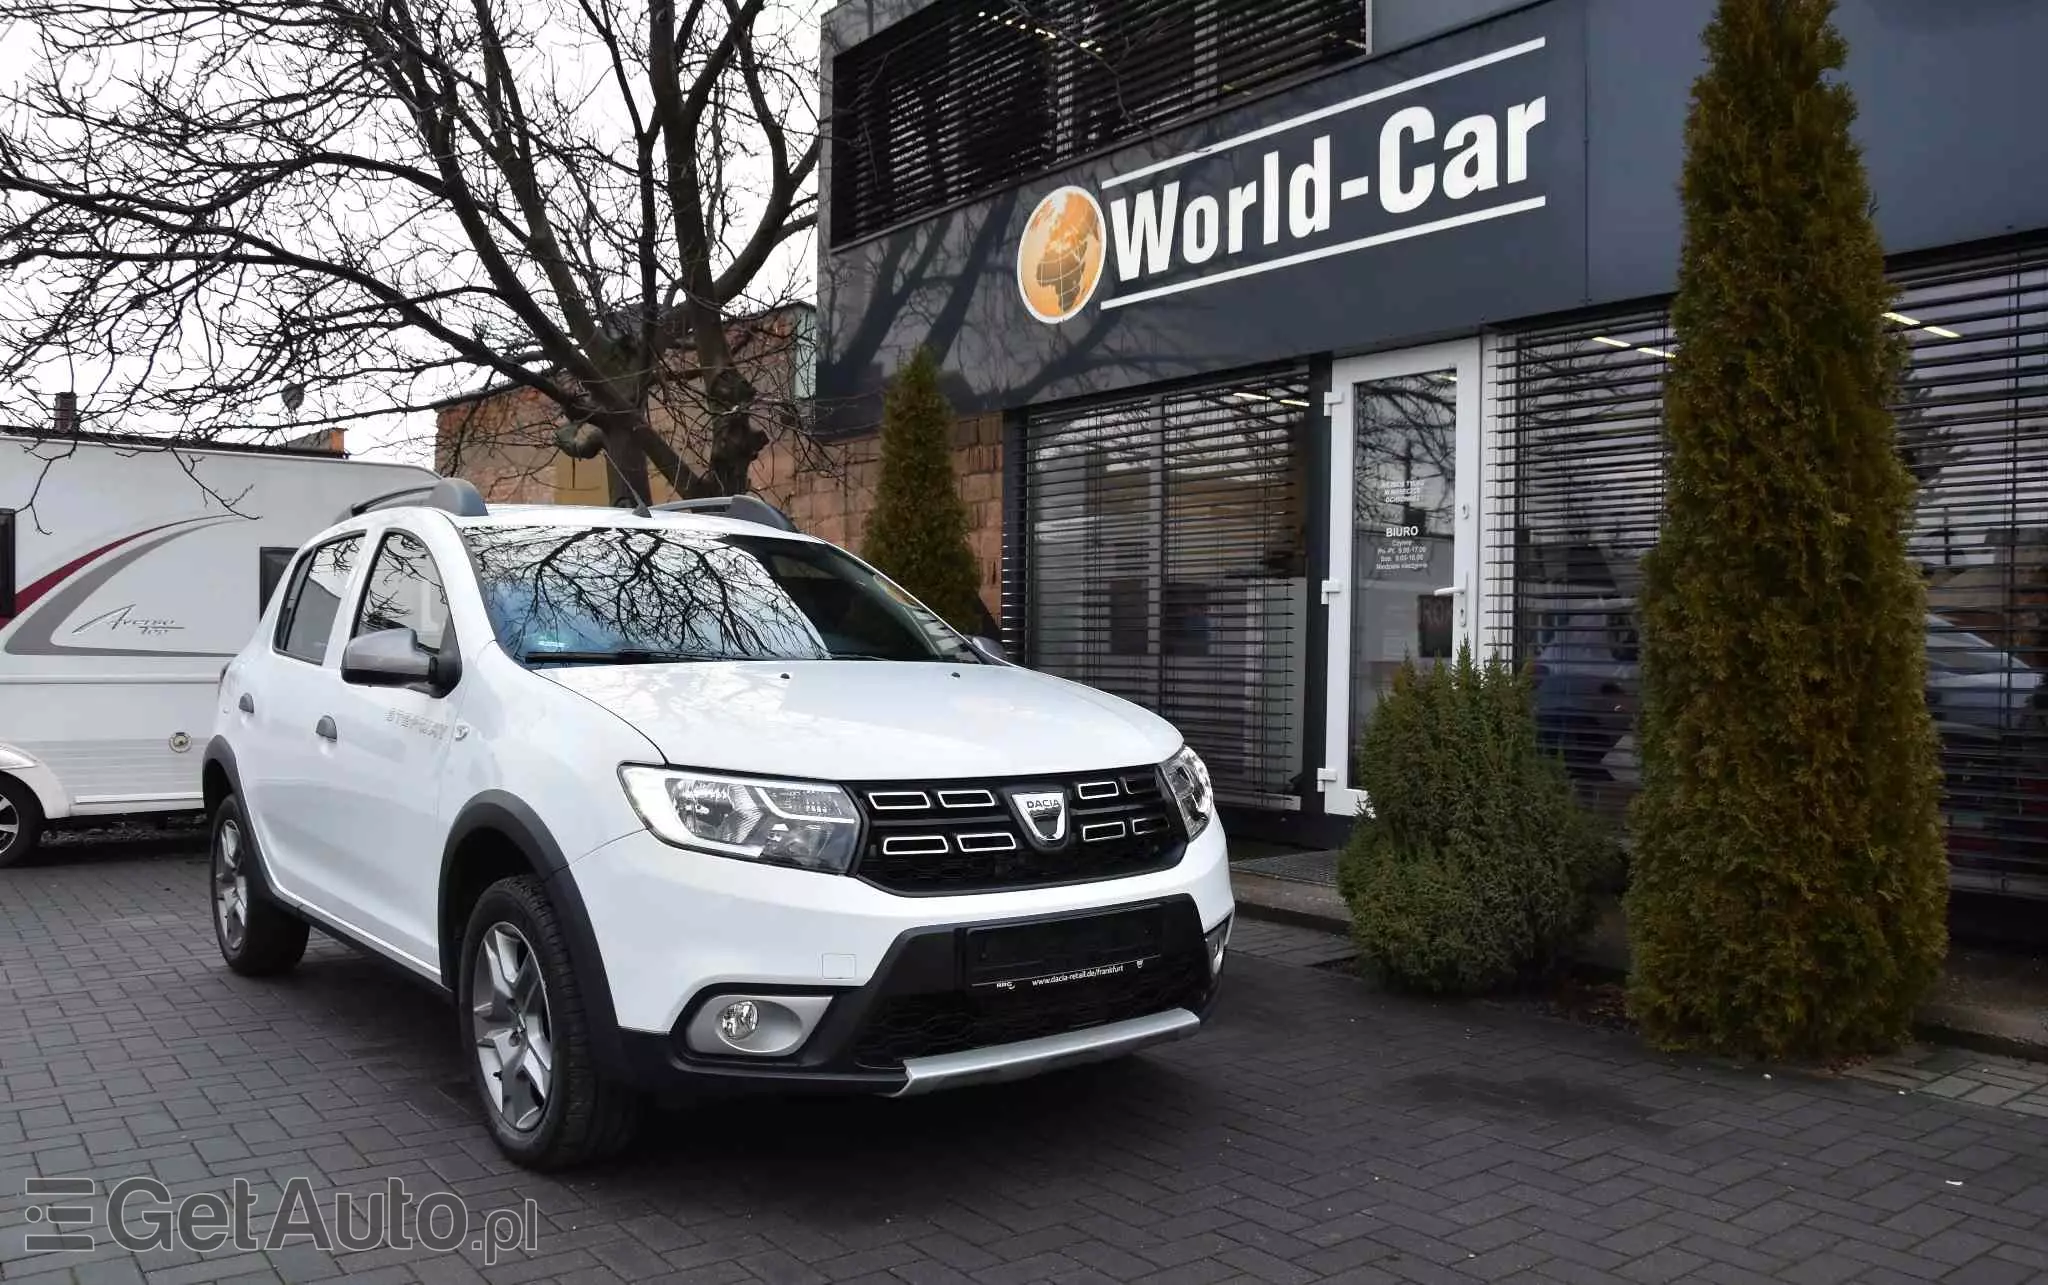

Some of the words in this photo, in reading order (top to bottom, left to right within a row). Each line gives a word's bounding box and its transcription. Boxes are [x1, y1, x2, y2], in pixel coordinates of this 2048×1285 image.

[1110, 96, 1546, 282] World-Car
[1385, 525, 1419, 537] BIURO
[1026, 799, 1060, 809] DACIA
[1032, 965, 1124, 987] www.dacia-retail.de/frankfurt
